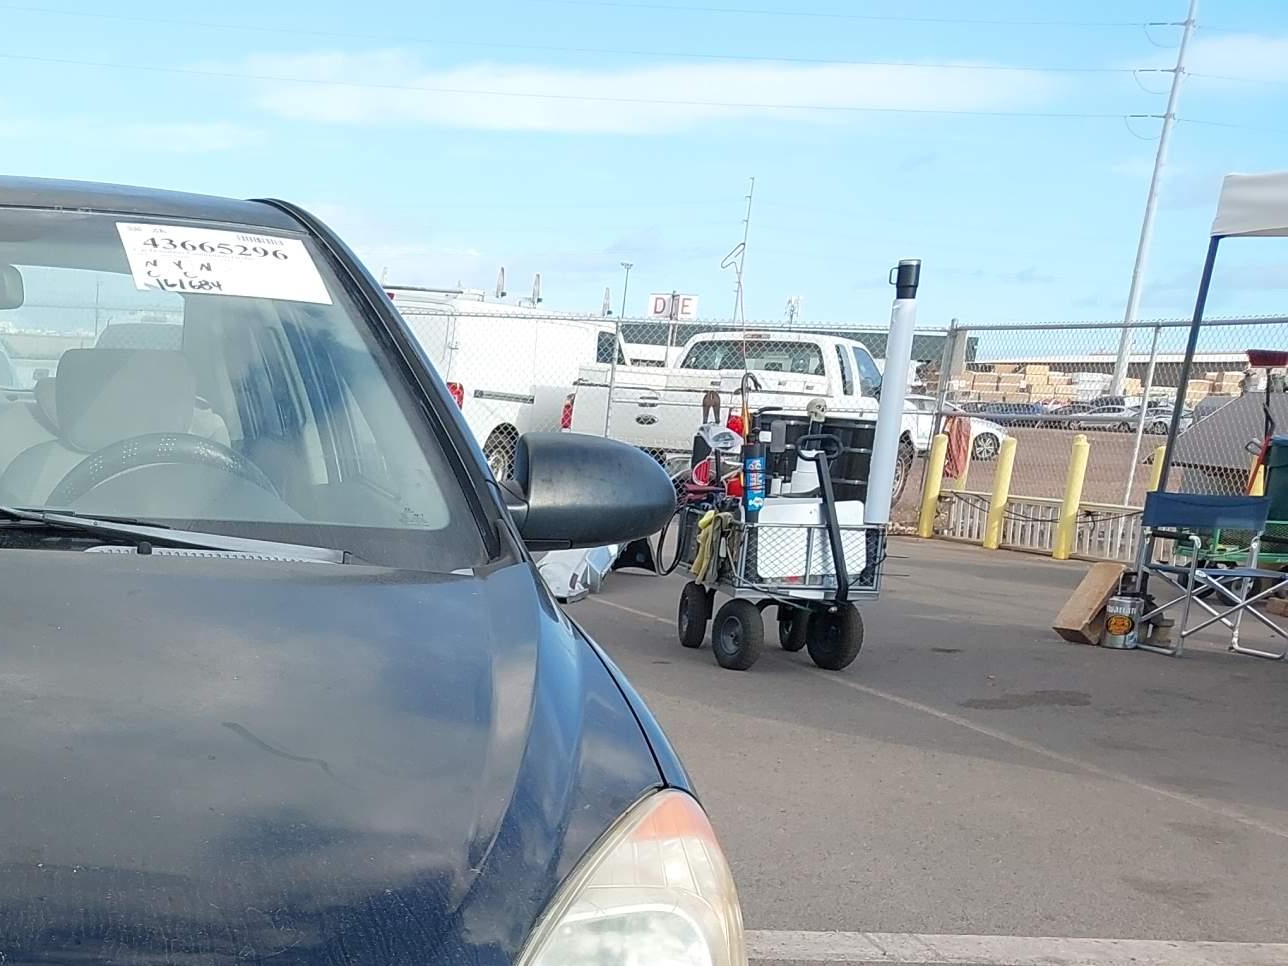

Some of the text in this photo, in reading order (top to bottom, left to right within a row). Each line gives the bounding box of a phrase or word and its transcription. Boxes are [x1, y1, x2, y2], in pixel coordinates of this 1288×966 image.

[143, 236, 289, 261] 43665296
[653, 296, 667, 315] D
[680, 297, 693, 315] E
